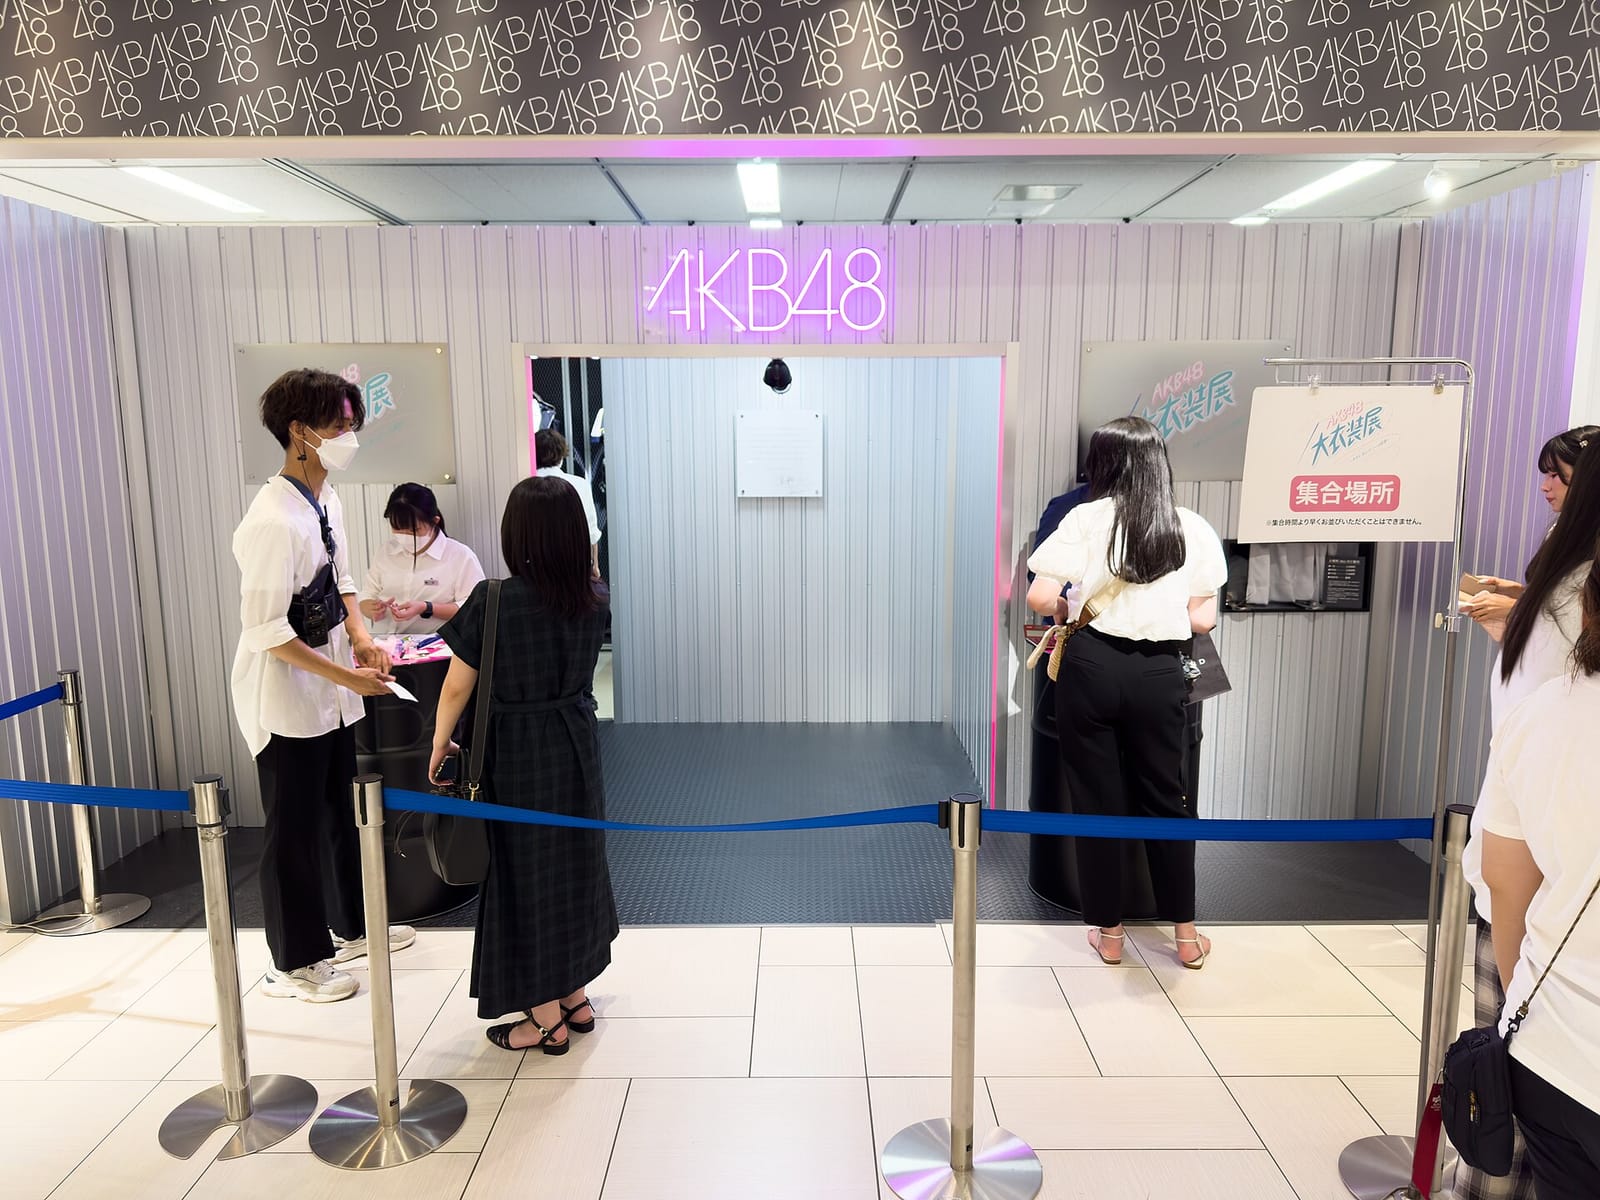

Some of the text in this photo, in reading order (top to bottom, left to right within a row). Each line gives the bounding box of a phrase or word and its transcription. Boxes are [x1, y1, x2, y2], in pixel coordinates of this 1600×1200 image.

[15, 18, 54, 57] 48
[74, 0, 113, 39] 48
[206, 6, 267, 51] AKB
[337, 11, 377, 50] 48
[470, 16, 531, 61] AKB
[529, 0, 591, 44] AKB
[660, 4, 701, 43] 48
[792, 9, 854, 54] AKB
[923, 14, 964, 53] 48
[1116, 1, 1178, 46] AKB
[1246, 6, 1287, 45] 48
[1378, 10, 1440, 55] AKB
[1508, 15, 1549, 54] 48
[147, 23, 208, 68] AKB
[278, 28, 318, 67] 48
[410, 33, 471, 78] AKB
[541, 39, 580, 78] 48
[600, 21, 640, 60] 48
[732, 26, 794, 71] AKB
[862, 31, 903, 70] 48
[994, 36, 1056, 81] AKB
[1055, 18, 1117, 63] AKB
[1185, 23, 1226, 62] 48
[1317, 28, 1379, 73] AKB
[1446, 33, 1487, 72] 48
[30, 57, 91, 102] AKB
[88, 40, 149, 85] AKB
[219, 46, 259, 85] 48
[351, 51, 412, 96] AKB
[481, 56, 521, 95] 48
[672, 44, 733, 89] AKB
[802, 49, 843, 88] 48
[933, 53, 995, 98] AKB
[1063, 58, 1104, 97] 48
[1124, 41, 1165, 80] 48
[1255, 46, 1317, 91] AKB
[1385, 50, 1426, 89] 48
[1516, 55, 1578, 100] AKB
[102, 80, 141, 119] 48
[160, 63, 200, 102] 48
[291, 68, 353, 113] AKB
[422, 73, 461, 112] 48
[552, 78, 614, 123] AKB
[612, 61, 673, 106] AKB
[742, 66, 782, 105] 48
[873, 71, 935, 116] AKB
[1003, 76, 1043, 115] 48
[1194, 63, 1256, 108] AKB
[1324, 68, 1365, 107] 48
[1454, 72, 1516, 117] AKB
[43, 97, 83, 136] 48
[232, 85, 294, 130] AKB
[363, 91, 402, 130] 48
[682, 84, 722, 123] 48
[813, 88, 874, 133] AKB
[942, 93, 983, 132] 48
[1133, 80, 1195, 125] AKB
[1262, 86, 1303, 125] 48
[647, 247, 887, 332] AKB48
[1152, 360, 1204, 405] AKB48
[1326, 400, 1364, 430] AKB48
[1311, 406, 1383, 466] 大衣装展
[1295, 480, 1394, 506] 集合場所
